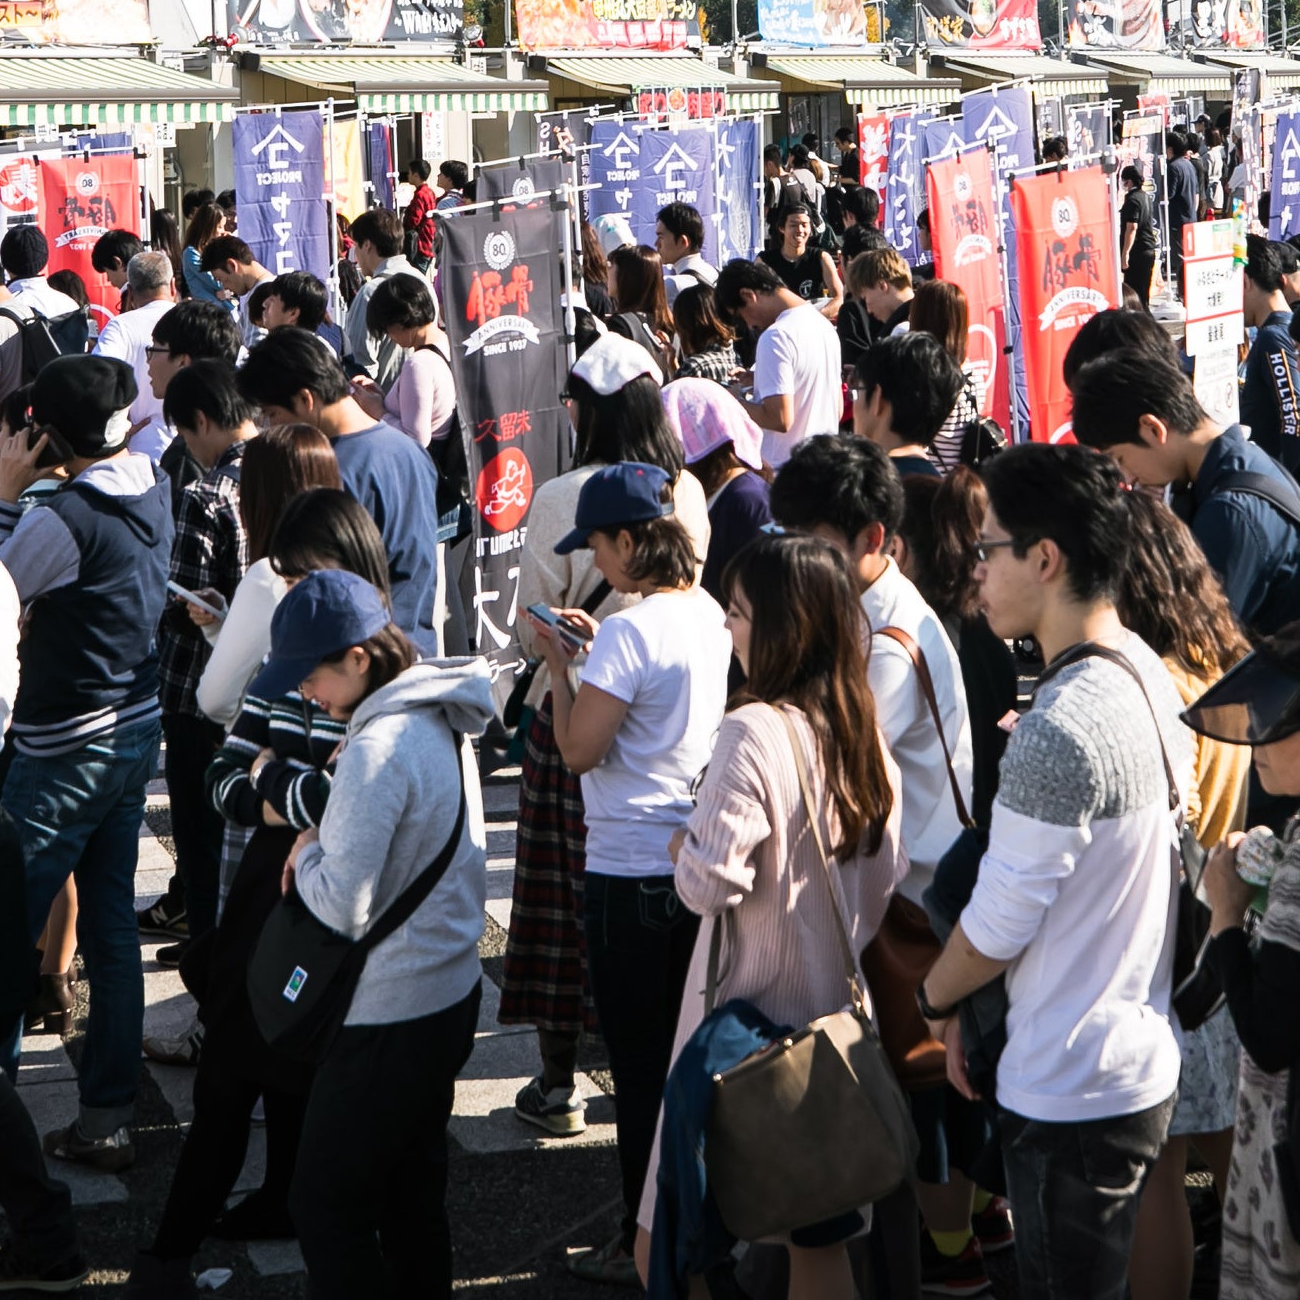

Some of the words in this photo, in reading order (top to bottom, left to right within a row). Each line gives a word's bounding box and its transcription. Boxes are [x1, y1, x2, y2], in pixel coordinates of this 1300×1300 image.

[466, 264, 534, 327] 豚骨
[483, 343, 508, 357] SINCE
[1269, 352, 1297, 437] HOLLISTER
[474, 409, 533, 444] 久留米
